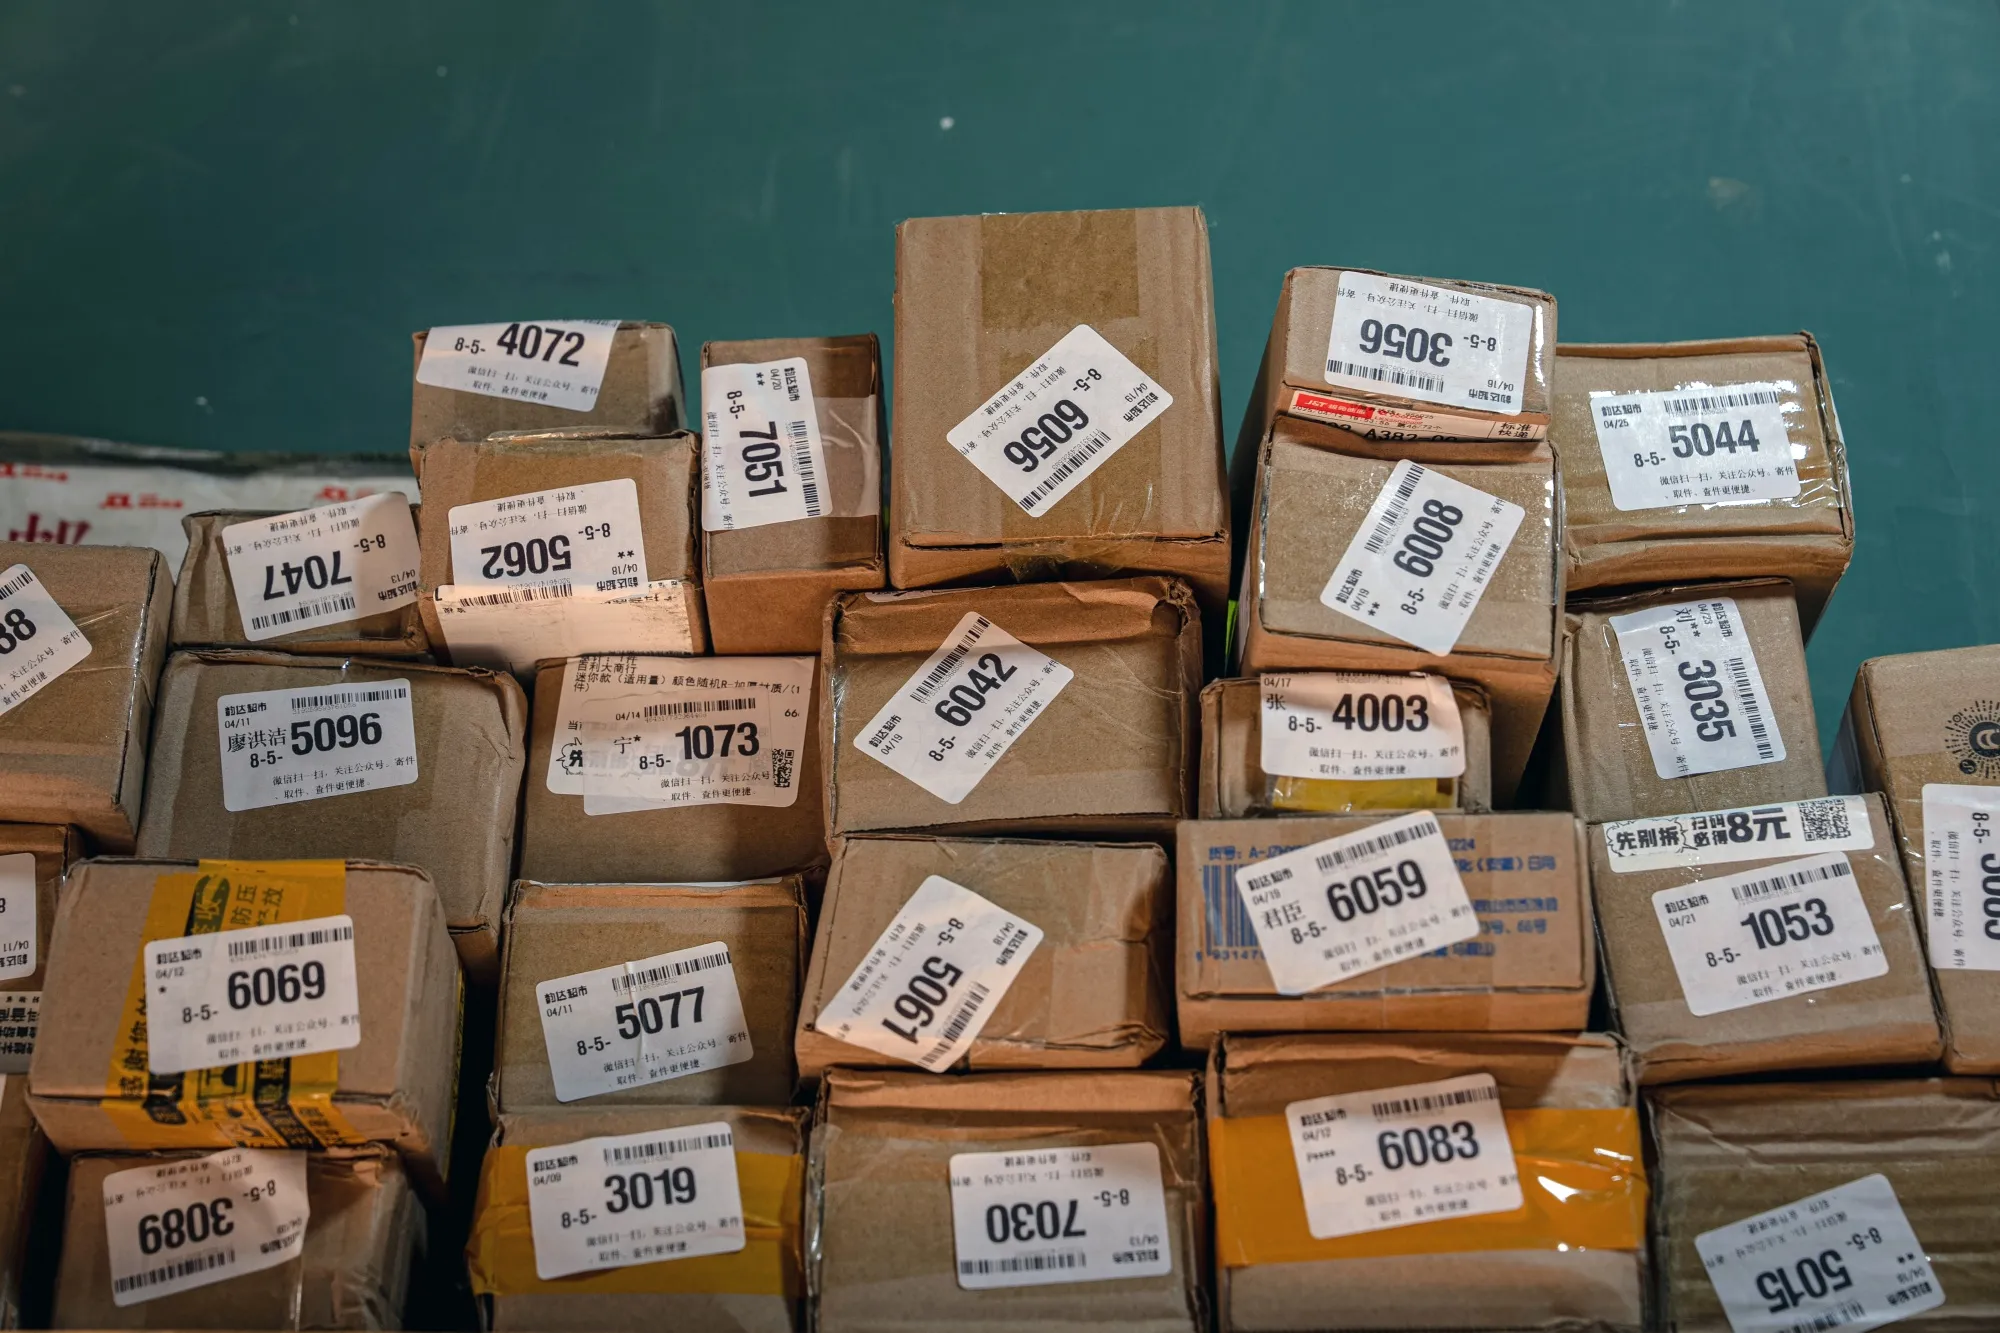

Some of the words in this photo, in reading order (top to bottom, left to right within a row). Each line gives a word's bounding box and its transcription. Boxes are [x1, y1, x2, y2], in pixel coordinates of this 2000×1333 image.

[454, 336, 486, 355] 8-5-
[496, 319, 585, 368] 4072
[1359, 318, 1453, 368] 3056
[1463, 334, 1497, 352] 8-5-
[770, 368, 783, 391] 04/20
[1072, 368, 1102, 392] 8-5-
[1124, 382, 1148, 403] 04/19
[1487, 379, 1515, 392] 04/16
[1122, 391, 1159, 423] 韵达超市
[1304, 399, 1328, 408] J&T
[1468, 388, 1512, 405] 韵达超市
[1601, 403, 1642, 417] 韵达超市
[1003, 399, 1090, 473] 6056
[1603, 418, 1630, 430] 04/25
[726, 390, 746, 420] 8-5-
[738, 420, 788, 498] 7051
[1633, 451, 1666, 468] 8-5-
[1668, 419, 1761, 459] 5044
[353, 533, 386, 553] 8-5-
[578, 522, 611, 541] 8-5-
[1392, 498, 1464, 578] 6008
[480, 534, 572, 580] 5062
[611, 563, 638, 576] 04/18
[262, 550, 353, 602] 7047
[390, 568, 416, 584] 04/13
[596, 576, 639, 592] 韵达超市
[377, 580, 419, 601] 韵达超市
[1350, 588, 1370, 612] 04/19
[1400, 587, 1425, 616] 8-5-
[1697, 601, 1713, 625] 04/23
[1710, 601, 1733, 638] 韵达超市
[934, 645, 1018, 727] 6042
[1263, 676, 1292, 689] 04/17
[1659, 625, 1681, 655] 8-5-
[1677, 659, 1737, 743] 3035
[224, 702, 267, 717] 韵达超市
[1265, 692, 1287, 710] 张
[1288, 715, 1323, 734] 8-5-
[1331, 693, 1430, 732] 4003
[224, 717, 250, 729] 04/11
[615, 711, 641, 721] 04/14
[227, 727, 287, 753] 廖洪洁
[249, 750, 284, 769] 8-5-
[290, 712, 383, 756] 5096
[868, 714, 902, 748] 韵达超市
[639, 753, 672, 770] 8-5-
[675, 721, 760, 760] 1073
[880, 733, 903, 756] 04/19
[928, 735, 956, 762] 8-5-
[1726, 807, 1792, 844] 8元
[1971, 812, 1991, 844] 8-5-
[1290, 921, 1327, 945] 8-5-
[1326, 859, 1428, 923] 6059
[937, 917, 965, 947] 8-5-
[1668, 913, 1696, 928] 04/21
[1705, 947, 1741, 968] 8-5-
[1740, 897, 1835, 950] 1053
[3, 939, 29, 953] 04/11
[155, 966, 185, 980] 04/12
[181, 1003, 218, 1024] 8-5-
[227, 960, 326, 1011] 6069
[544, 985, 588, 1005] 韵达超市
[881, 955, 964, 1045] 5061
[546, 1003, 573, 1018] 04/11
[576, 1035, 612, 1056] 8-5-
[615, 985, 705, 1041] 5077
[1335, 1163, 1373, 1187] 8-5-
[1377, 1119, 1480, 1171] 6083
[533, 1172, 562, 1187] 04/09
[242, 1179, 276, 1207] 8-5-
[561, 1208, 597, 1229] 8-5-
[604, 1166, 697, 1214] 3019
[1093, 1188, 1130, 1208] 8-5-
[137, 1197, 235, 1256] 3089
[985, 1199, 1087, 1244] 7030
[1846, 1227, 1883, 1251] 8-5-
[1755, 1249, 1853, 1315] 5015
